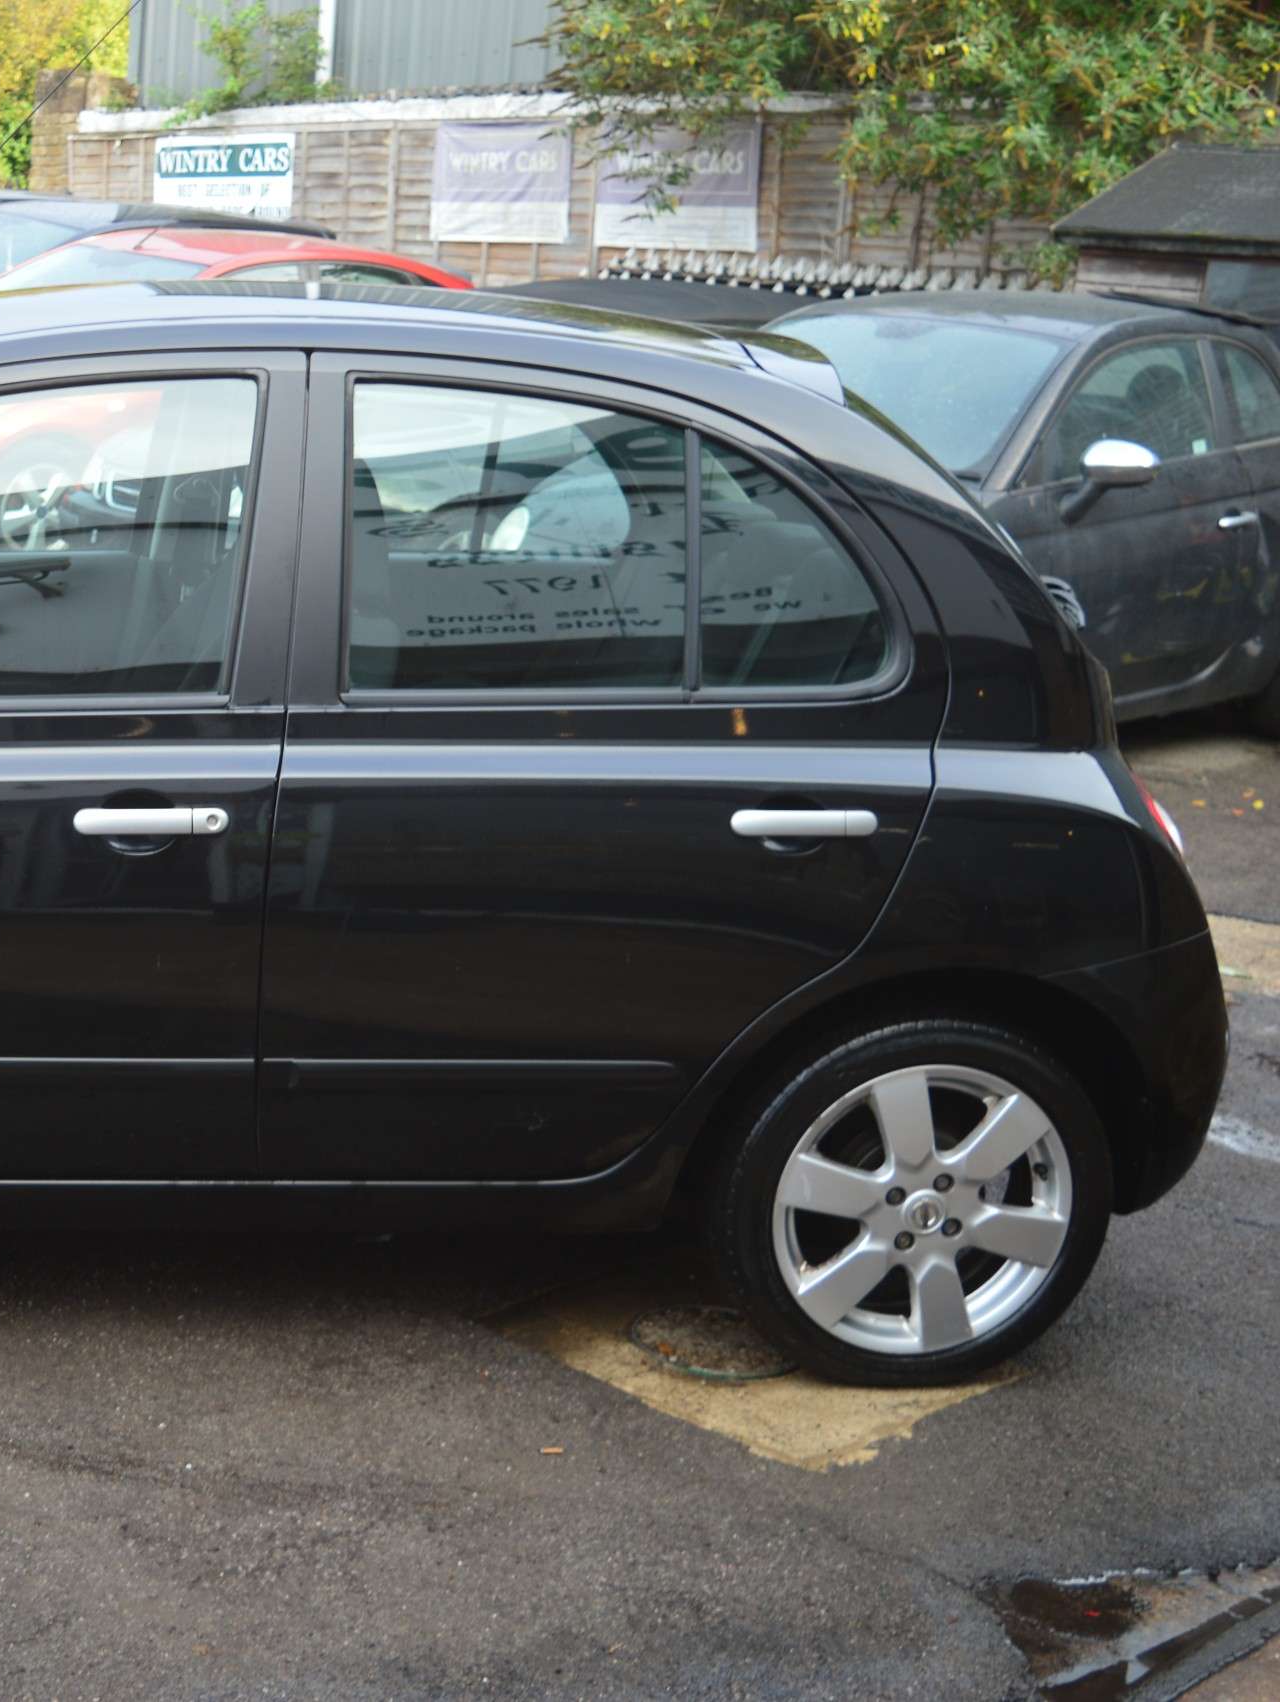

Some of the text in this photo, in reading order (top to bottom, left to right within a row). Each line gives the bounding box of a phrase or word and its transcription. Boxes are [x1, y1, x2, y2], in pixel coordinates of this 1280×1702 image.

[159, 147, 290, 174] WINTRY CARS
[448, 150, 559, 173] WINTRY CARS
